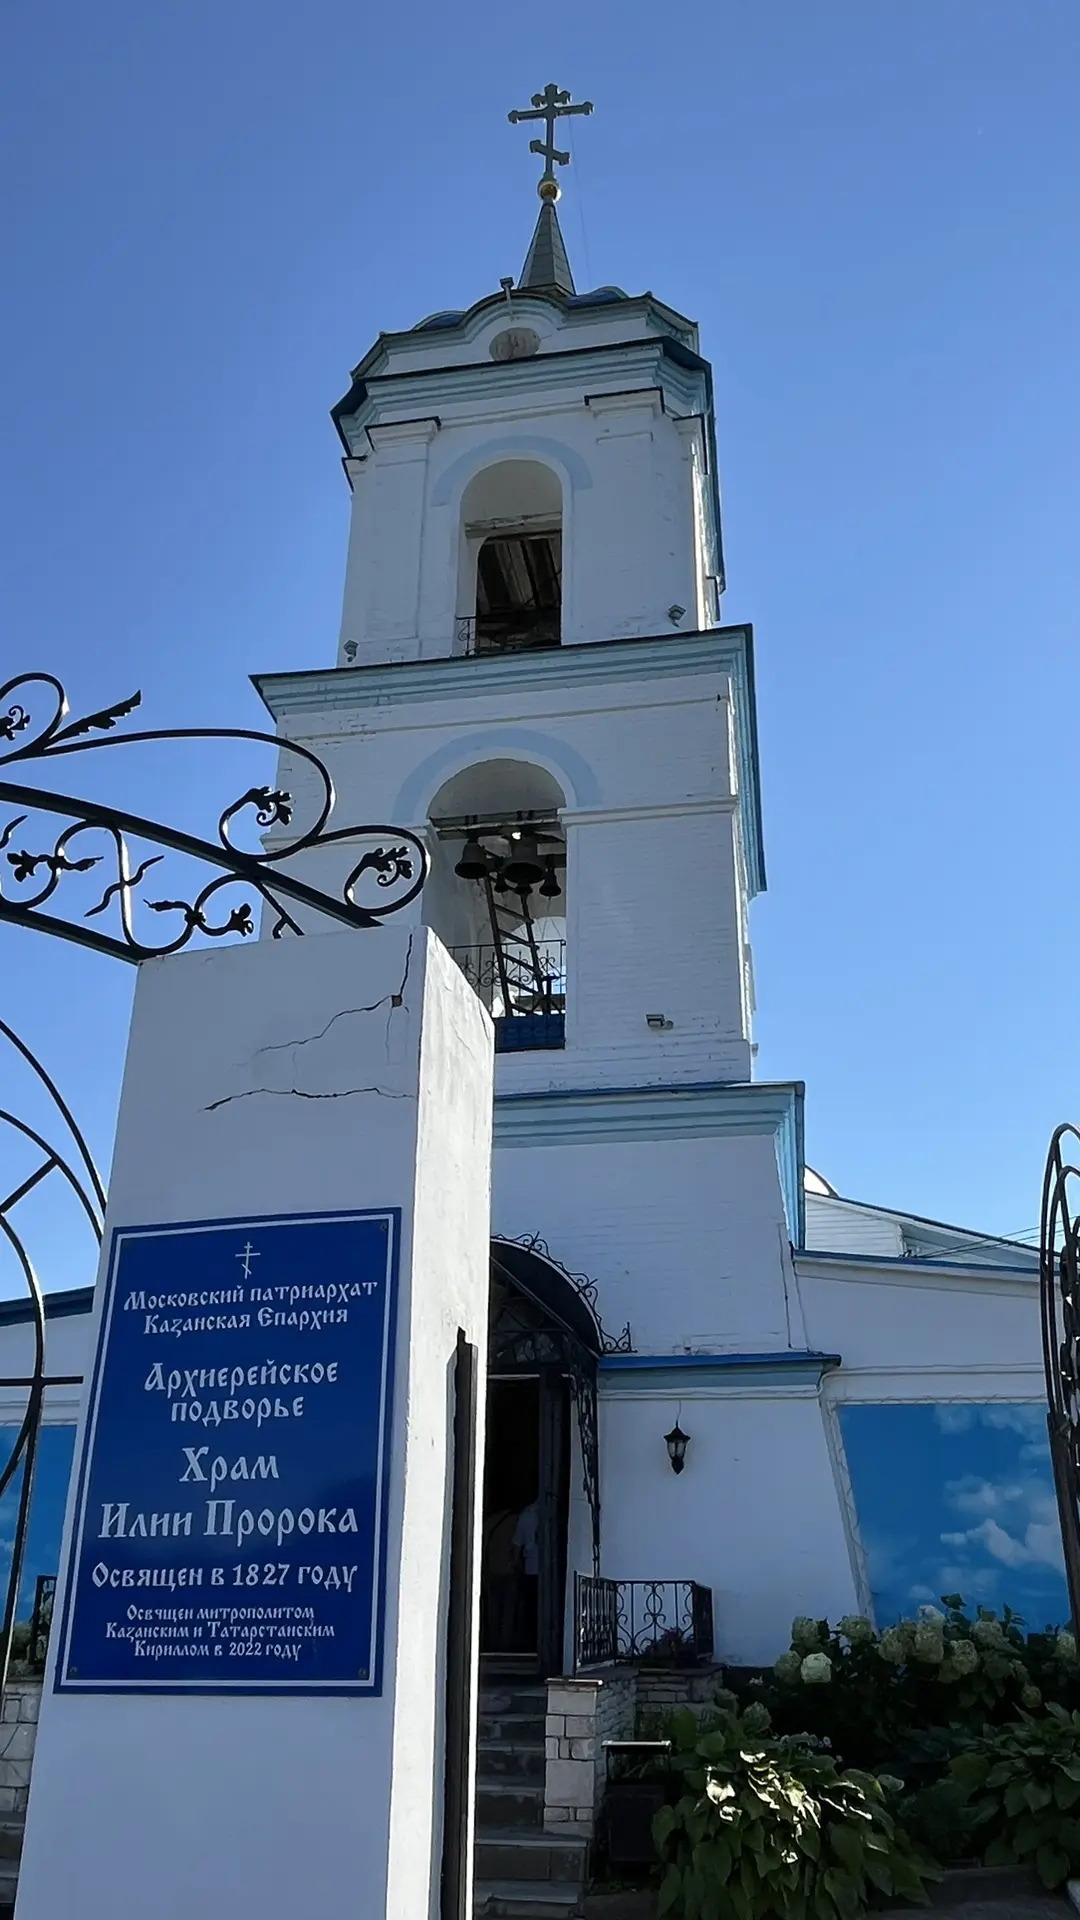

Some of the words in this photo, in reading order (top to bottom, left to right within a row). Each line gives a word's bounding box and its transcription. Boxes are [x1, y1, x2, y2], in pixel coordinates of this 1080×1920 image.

[123, 1285, 244, 1311] Московский
[250, 1281, 378, 1306] патриархат
[143, 1314, 251, 1338] Казанская
[144, 1359, 339, 1398] Архиерейское
[171, 1396, 304, 1427] подворье
[178, 1446, 280, 1493] Храм
[97, 1502, 193, 1538] Илии
[203, 1499, 359, 1547] Пророка
[92, 1562, 203, 1592] Освящен
[210, 1567, 225, 1586] в
[232, 1563, 291, 1586] 1827
[298, 1565, 358, 1593] году
[196, 1606, 315, 1624] митрополитом
[105, 1622, 190, 1643] Казанским
[193, 1626, 203, 1638] и
[207, 1621, 335, 1643] Татарстанским
[134, 1640, 210, 1661] Кириллом
[214, 1644, 223, 1656] в
[228, 1642, 263, 1656] 2022
[265, 1644, 302, 1662] году
